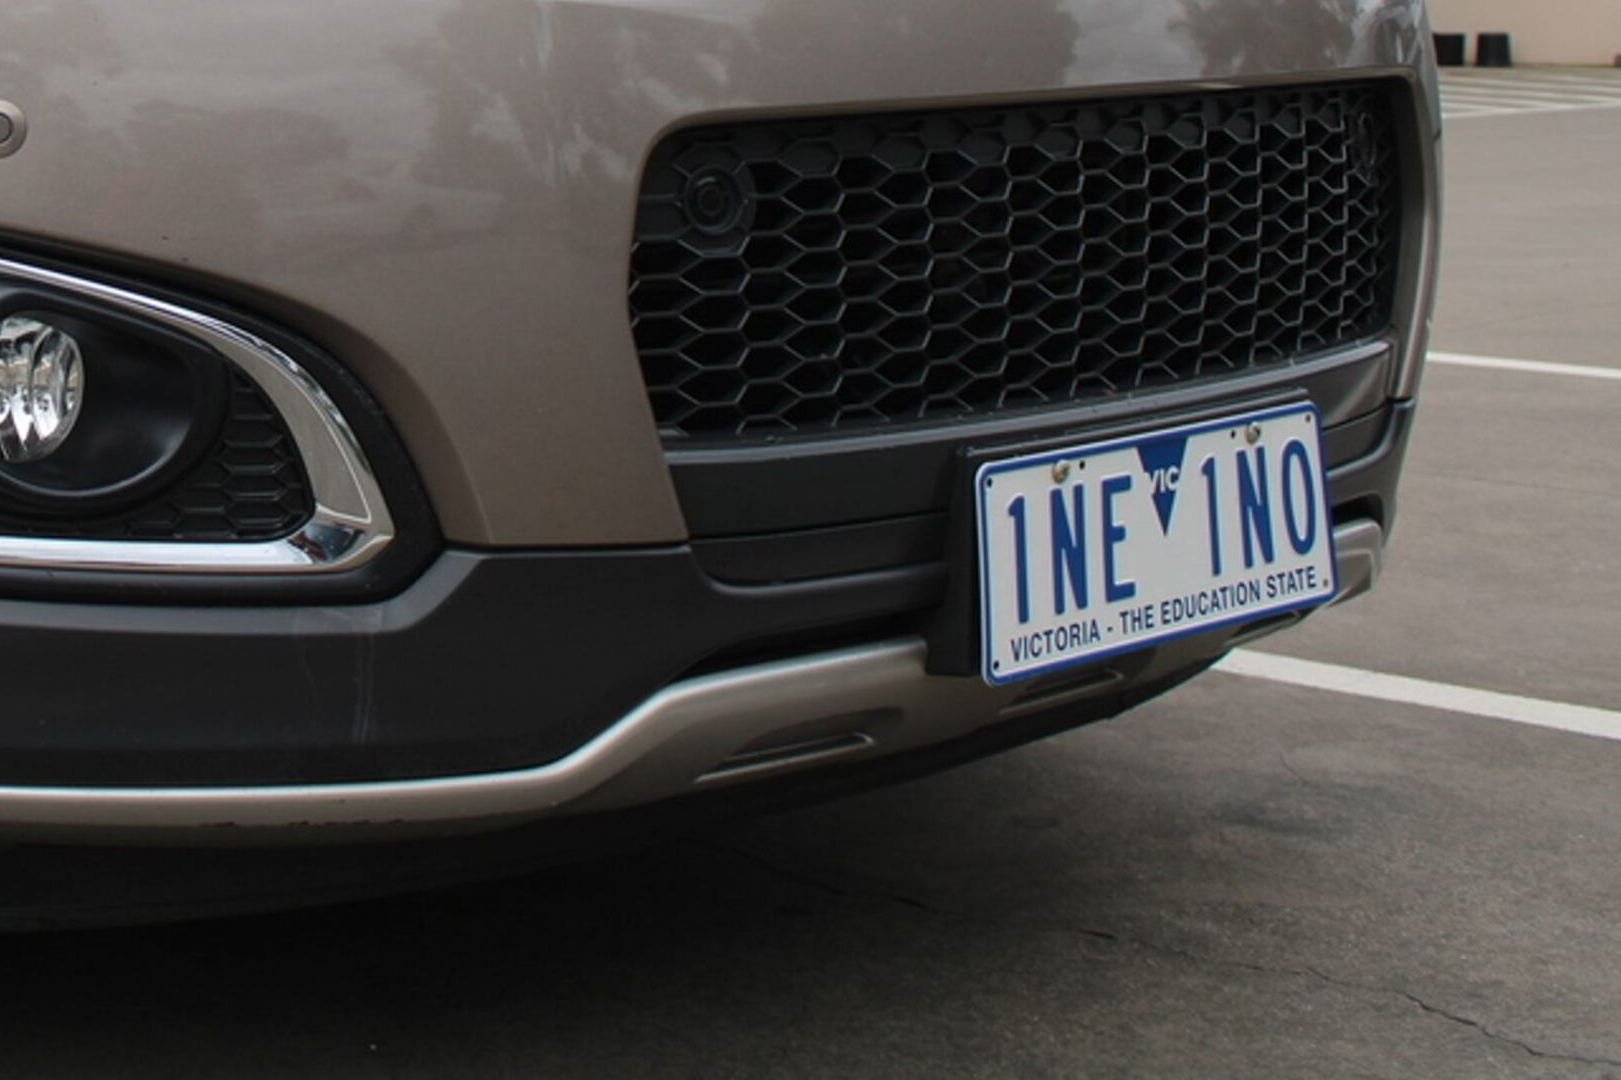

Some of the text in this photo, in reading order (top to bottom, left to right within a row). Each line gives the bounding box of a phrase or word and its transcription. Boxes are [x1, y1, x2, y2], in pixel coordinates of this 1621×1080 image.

[1008, 438, 1317, 625] 1NE 1NO
[1010, 618, 1101, 662] VICTORIA
[1120, 604, 1154, 635] THE
[1160, 582, 1261, 625] EDUCATION
[1267, 566, 1317, 599] STATE
